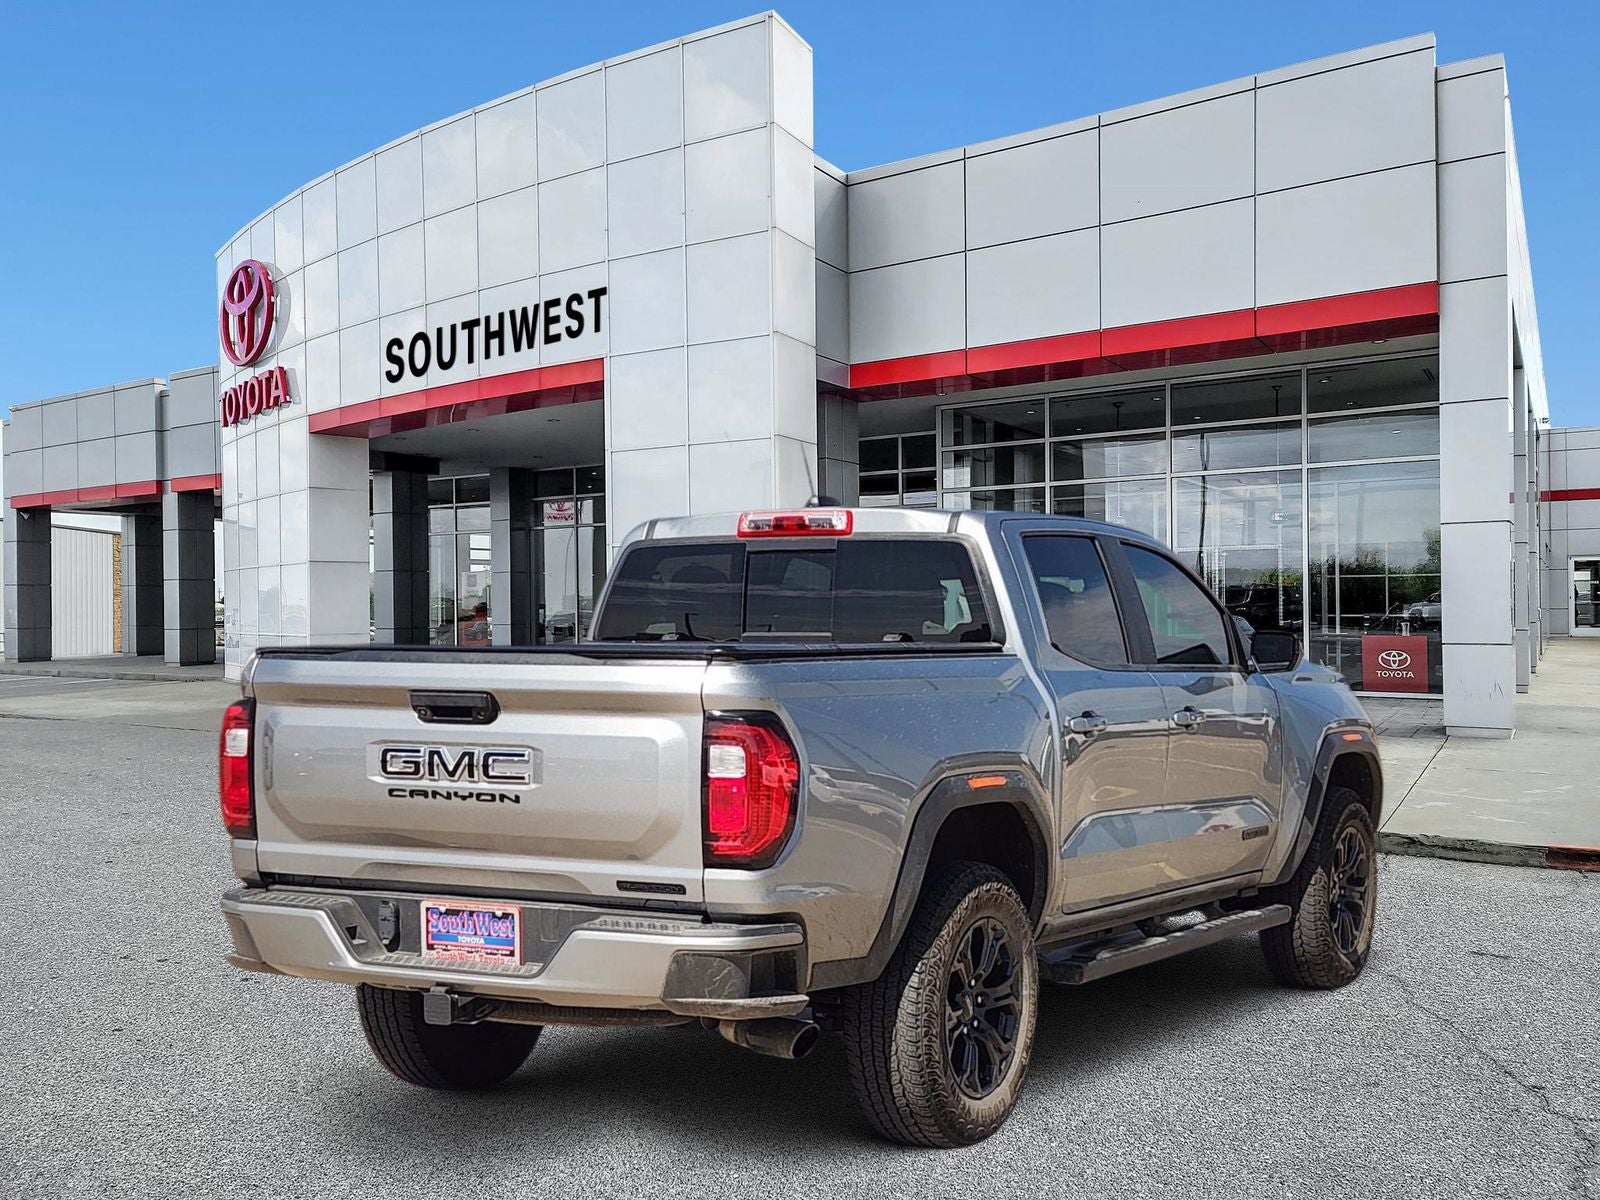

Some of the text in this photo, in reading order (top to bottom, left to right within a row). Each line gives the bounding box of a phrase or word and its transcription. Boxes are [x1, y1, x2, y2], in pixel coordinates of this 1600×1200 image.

[385, 287, 608, 384] SOUTHWEST
[219, 366, 290, 428] TOYOTA
[380, 745, 532, 784] GMC
[388, 788, 521, 804] CANYON
[457, 936, 485, 944] TOYOTA
